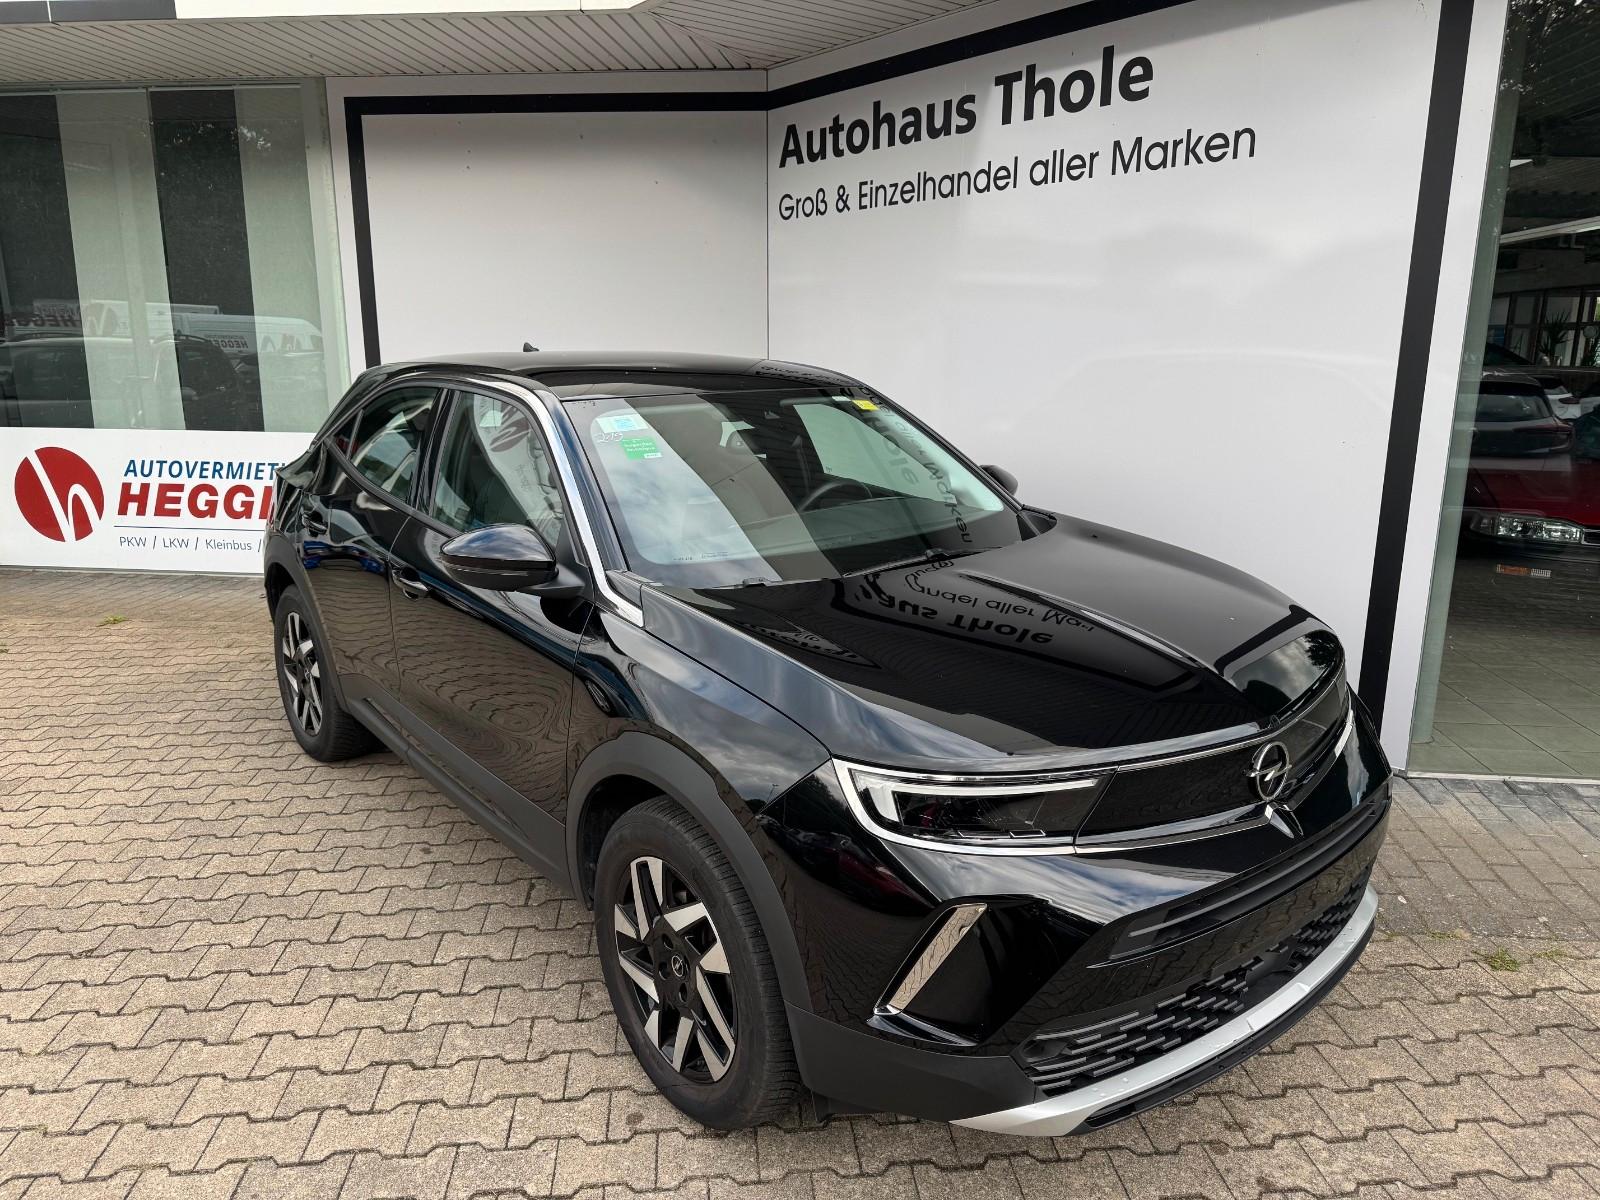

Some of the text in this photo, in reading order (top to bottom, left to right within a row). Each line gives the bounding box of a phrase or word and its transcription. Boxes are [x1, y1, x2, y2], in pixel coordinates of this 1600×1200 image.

[779, 44, 1154, 168] Autohaus Thole
[779, 127, 1256, 221] Groß & Einzelhandel aller Marken
[124, 459, 285, 481] AUTOVERMIET
[119, 536, 148, 548] PKW
[163, 537, 190, 549] LKW
[205, 539, 252, 552] Kleinbus
